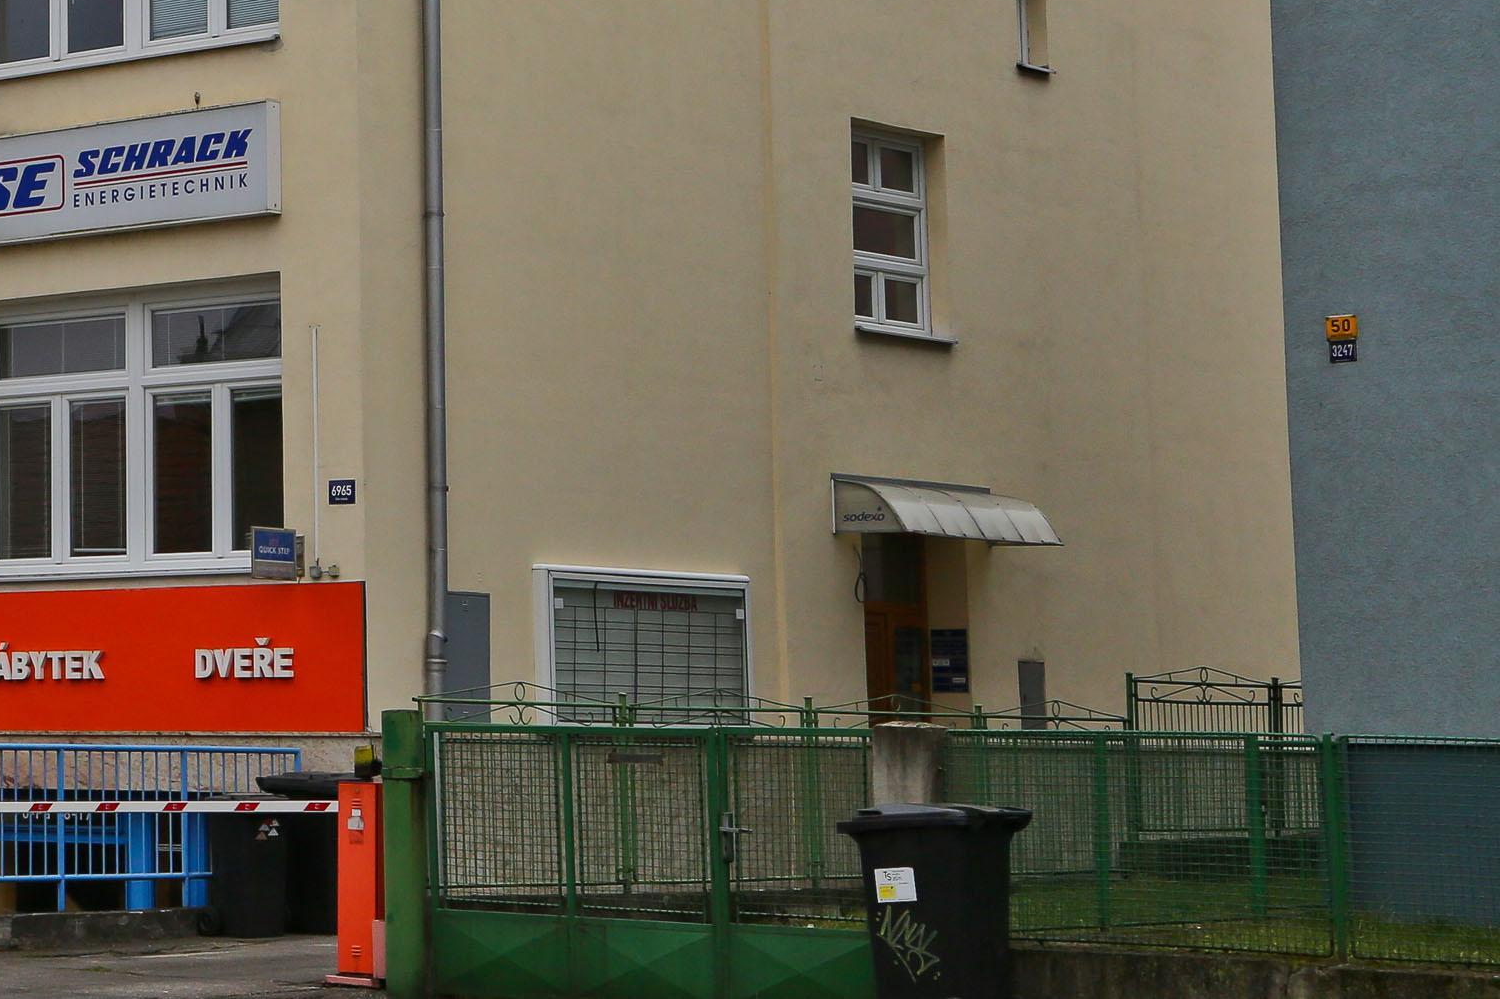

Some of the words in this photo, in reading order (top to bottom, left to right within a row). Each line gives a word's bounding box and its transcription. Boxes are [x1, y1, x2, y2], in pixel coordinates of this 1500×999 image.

[73, 128, 253, 179] SCHRACK
[73, 173, 249, 208] ENERGIETECHNIK
[1331, 319, 1351, 333] 50
[1331, 344, 1353, 357] 3247
[331, 485, 352, 497] 6965
[843, 511, 886, 522] sodexo
[194, 637, 295, 679] DVEŘE
